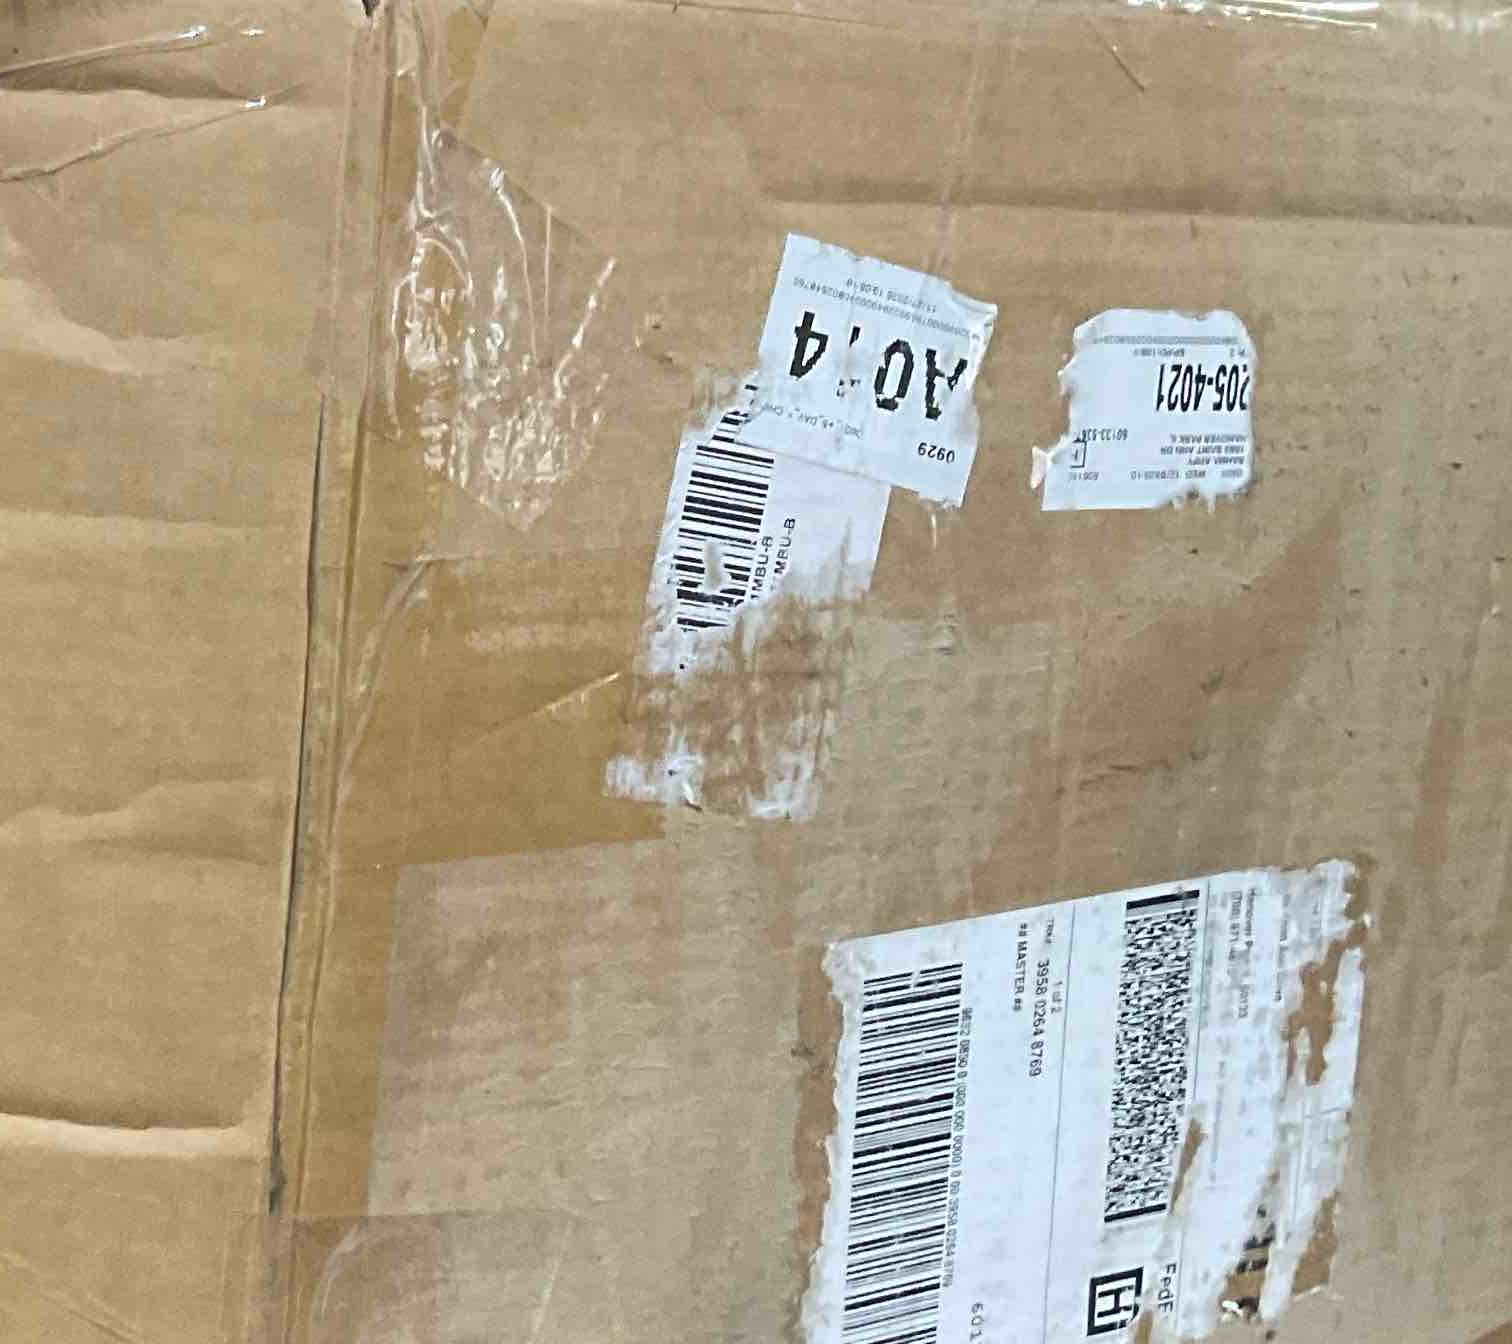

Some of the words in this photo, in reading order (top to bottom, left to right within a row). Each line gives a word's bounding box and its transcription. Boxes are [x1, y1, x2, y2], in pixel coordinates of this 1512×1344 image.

[788, 311, 967, 421] A04
[918, 442, 956, 464] 0929
[1014, 940, 1027, 994] MASTER
[1034, 959, 1050, 996] 3958
[1032, 999, 1047, 1036] 0264
[1029, 1041, 1044, 1078] 8769
[1158, 1262, 1177, 1315] FedE
